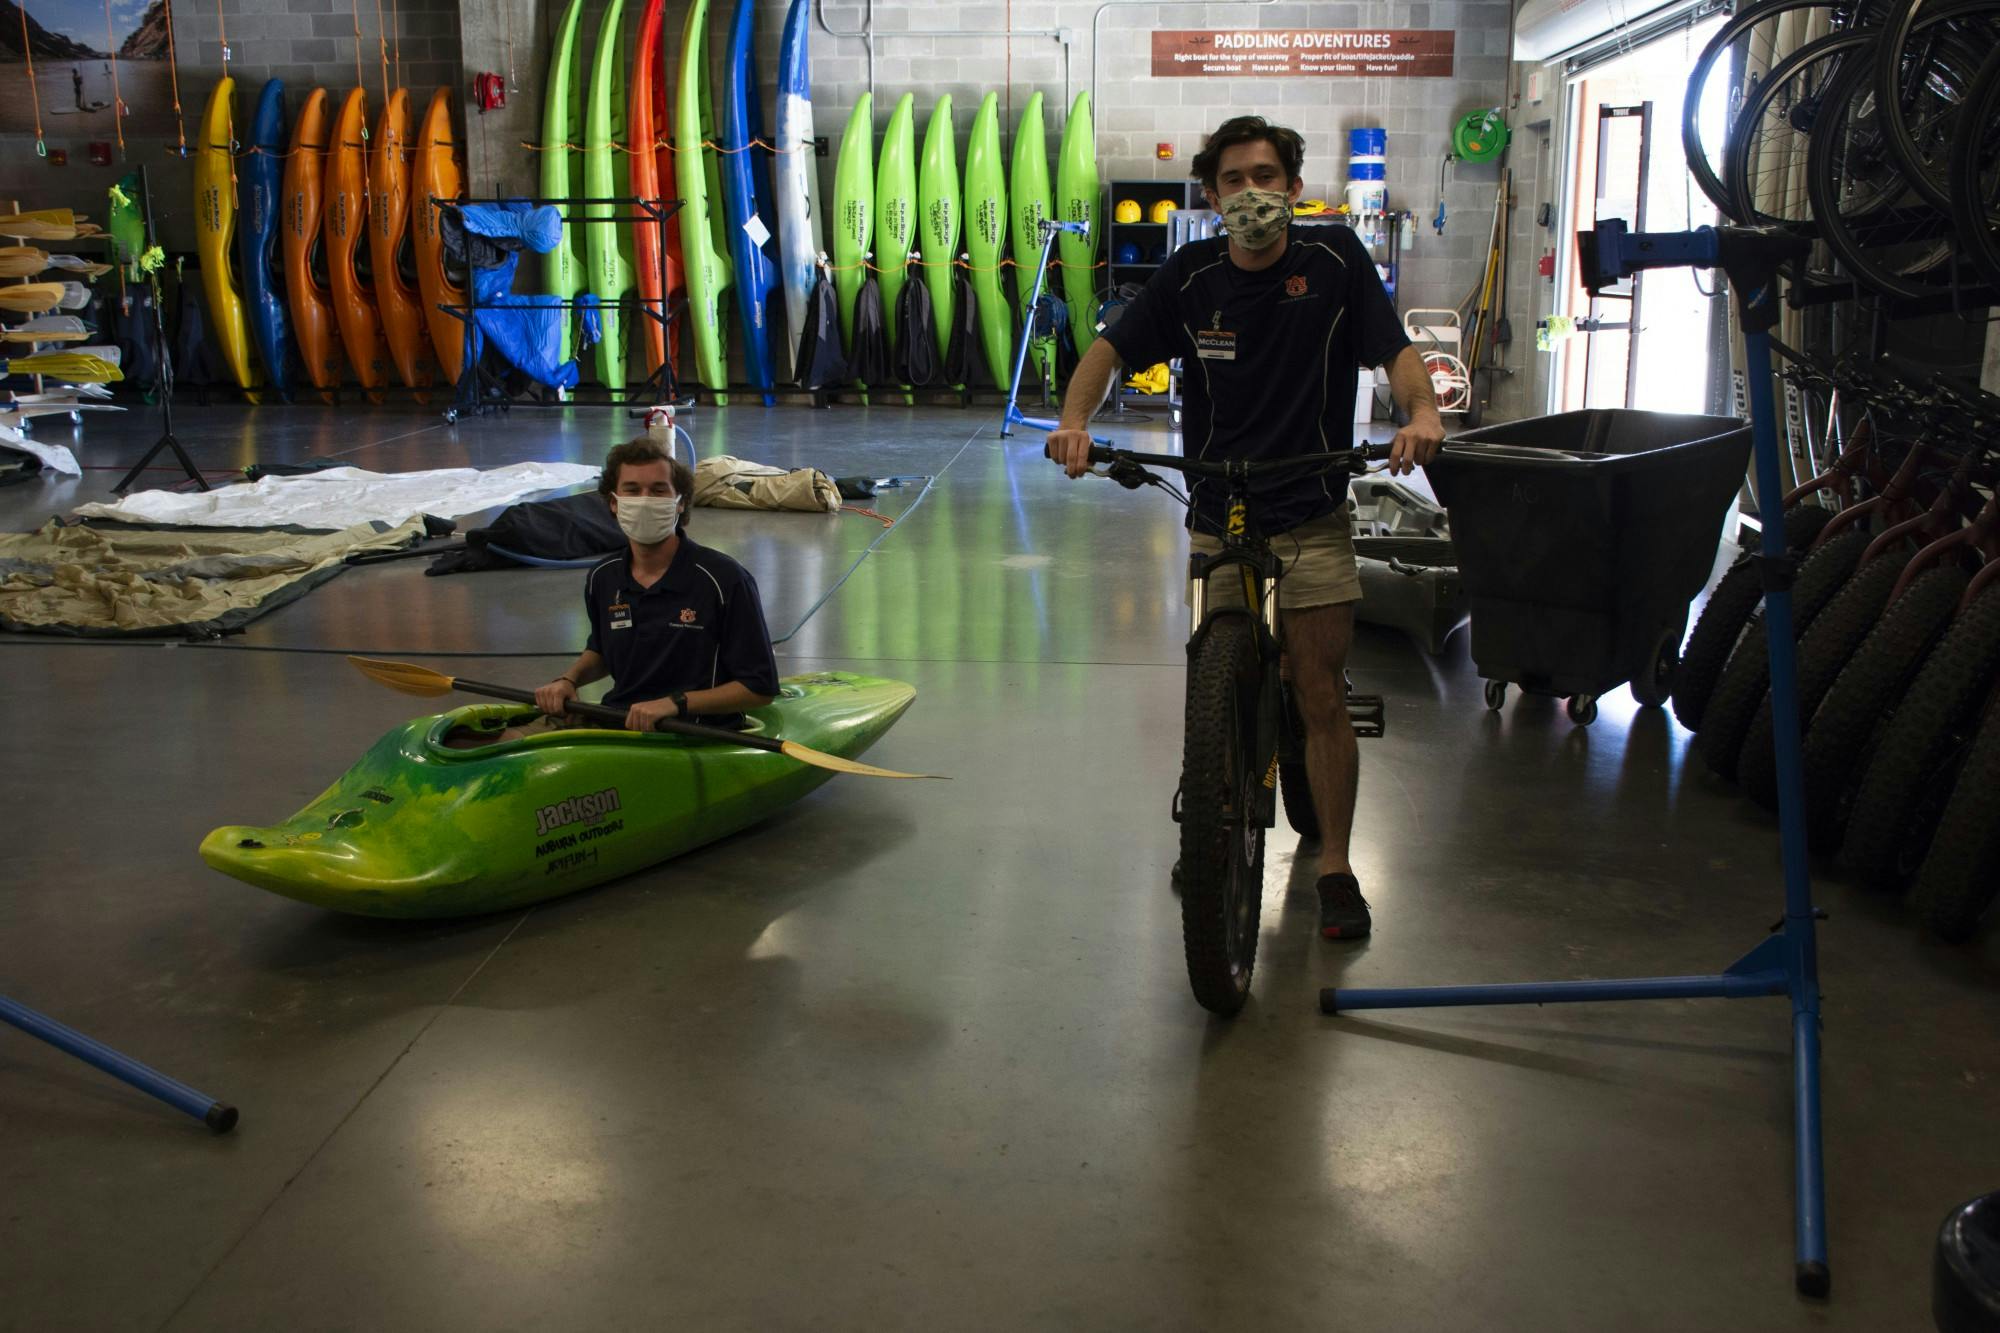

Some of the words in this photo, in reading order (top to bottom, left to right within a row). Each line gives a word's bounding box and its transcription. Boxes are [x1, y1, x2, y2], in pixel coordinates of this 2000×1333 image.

[1214, 33, 1290, 49] PADDLING
[1292, 33, 1391, 48] ADVENTURES
[1174, 53, 1192, 62] Right
[1232, 54, 1247, 62] type
[1256, 54, 1289, 62] waterway
[1300, 53, 1323, 62] Proper
[1324, 53, 1332, 61] fit
[1333, 53, 1340, 61] of
[1202, 64, 1226, 72] Secure
[1226, 64, 1241, 72] boat
[1252, 64, 1269, 72] Have
[1274, 64, 1290, 73] plan
[1300, 64, 1320, 72] Know
[1320, 65, 1336, 73] your
[1336, 64, 1356, 72] limits
[1366, 64, 1383, 72] Have
[1384, 64, 1398, 72] fun!
[535, 833, 577, 858] AUBURN
[578, 818, 625, 843] OUTDOORS
